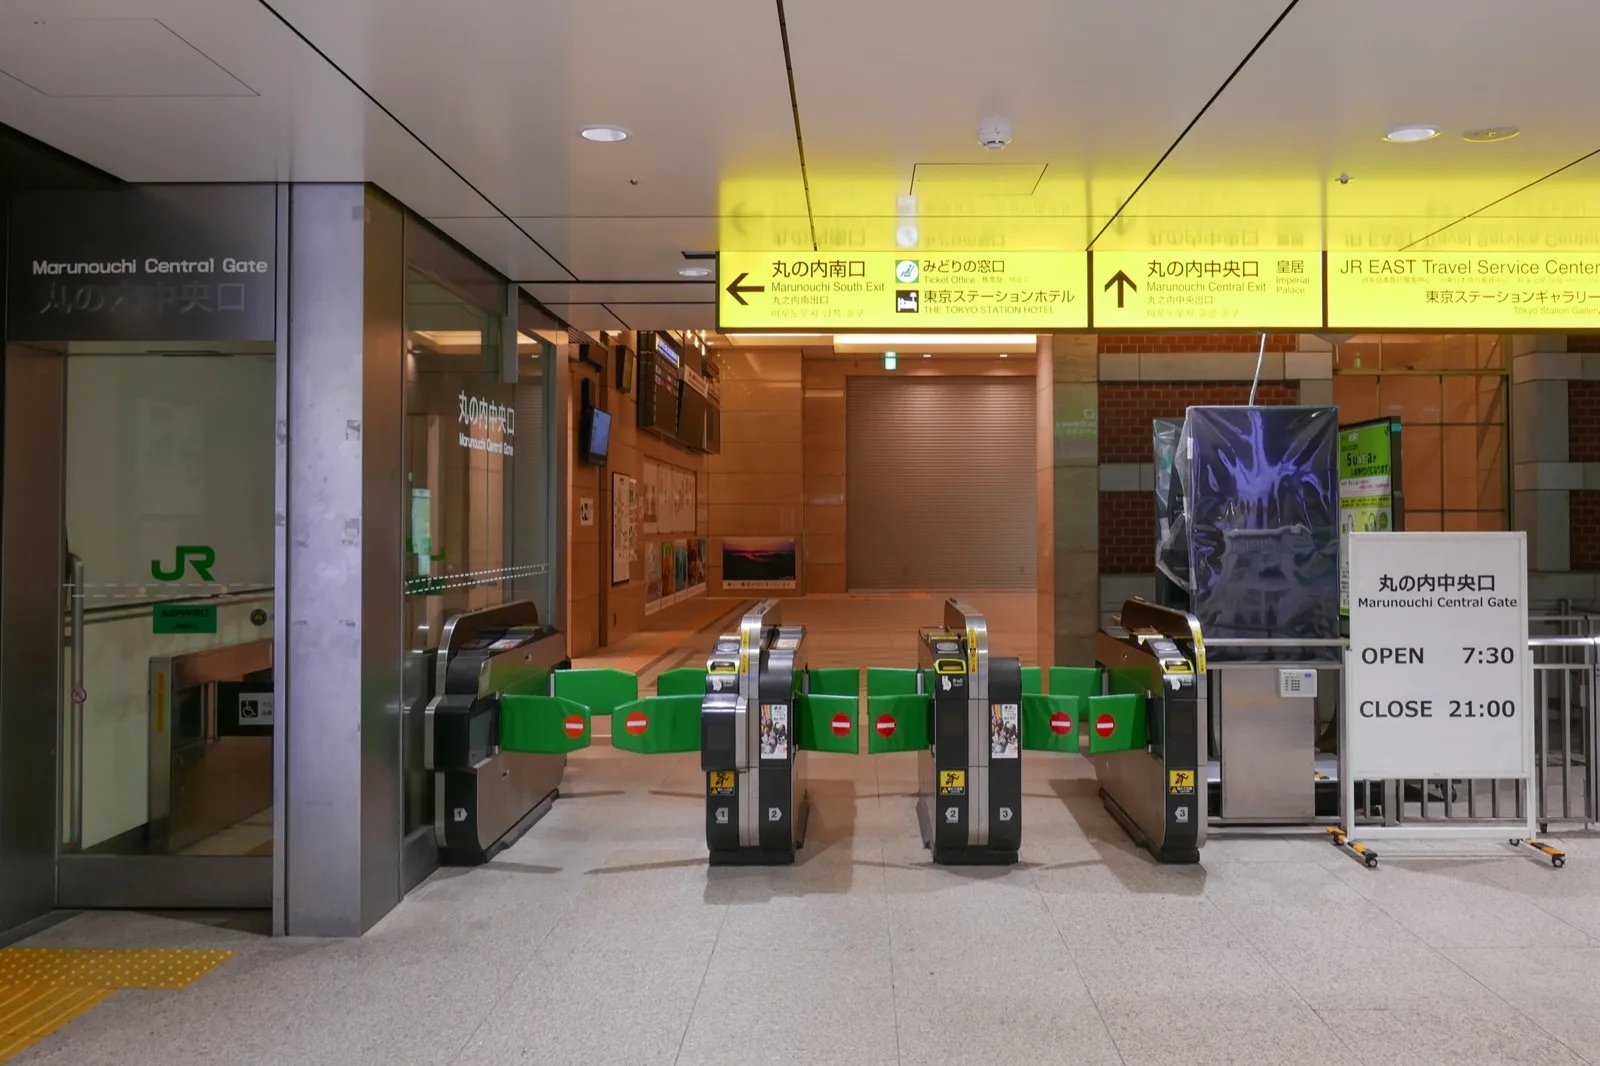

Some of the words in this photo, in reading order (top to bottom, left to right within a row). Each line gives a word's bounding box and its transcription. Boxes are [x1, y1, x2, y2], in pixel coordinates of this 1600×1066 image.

[32, 259, 136, 275] Marunouchi
[144, 258, 214, 273] Central
[222, 257, 268, 273] Gate
[772, 260, 865, 278] 丸の内南口
[923, 259, 1005, 273] みどりの窓口
[1147, 260, 1259, 278] 丸の内中央口
[1276, 260, 1304, 274] 皇居
[1340, 259, 1362, 274] JR
[1369, 259, 1416, 274] EAST
[1422, 259, 1471, 274] Travel
[1477, 259, 1540, 274] Service
[1545, 259, 1600, 274] Center
[771, 281, 830, 292] Marunouchi
[833, 281, 862, 292] South
[866, 281, 884, 292] Exit
[924, 276, 949, 284] Ticket
[951, 276, 976, 284] Office
[1147, 281, 1205, 292] Marunouchi
[1208, 281, 1244, 292] Central
[1247, 281, 1266, 292] Exit
[1276, 276, 1310, 285] Imperial
[923, 289, 1075, 304] 東京ステーションホテル
[1276, 286, 1305, 294] Palace
[1425, 290, 1600, 304] 東京ステーションギャラリー
[945, 305, 978, 314] TOKYO
[981, 305, 1020, 314] STATION
[1023, 305, 1055, 314] HOTEL
[1540, 306, 1570, 315] Station
[458, 389, 515, 436] 丸の内中央口
[151, 546, 216, 581] JR
[1378, 574, 1495, 592] 丸の内中央口
[1358, 597, 1433, 608] Marunouchi
[1437, 597, 1483, 608] Central
[1487, 597, 1518, 608] Gate
[1361, 647, 1424, 664] OPEN
[1462, 647, 1514, 664] 7:30
[1359, 700, 1433, 718] CLOSE
[1448, 700, 1515, 718] 21:00
